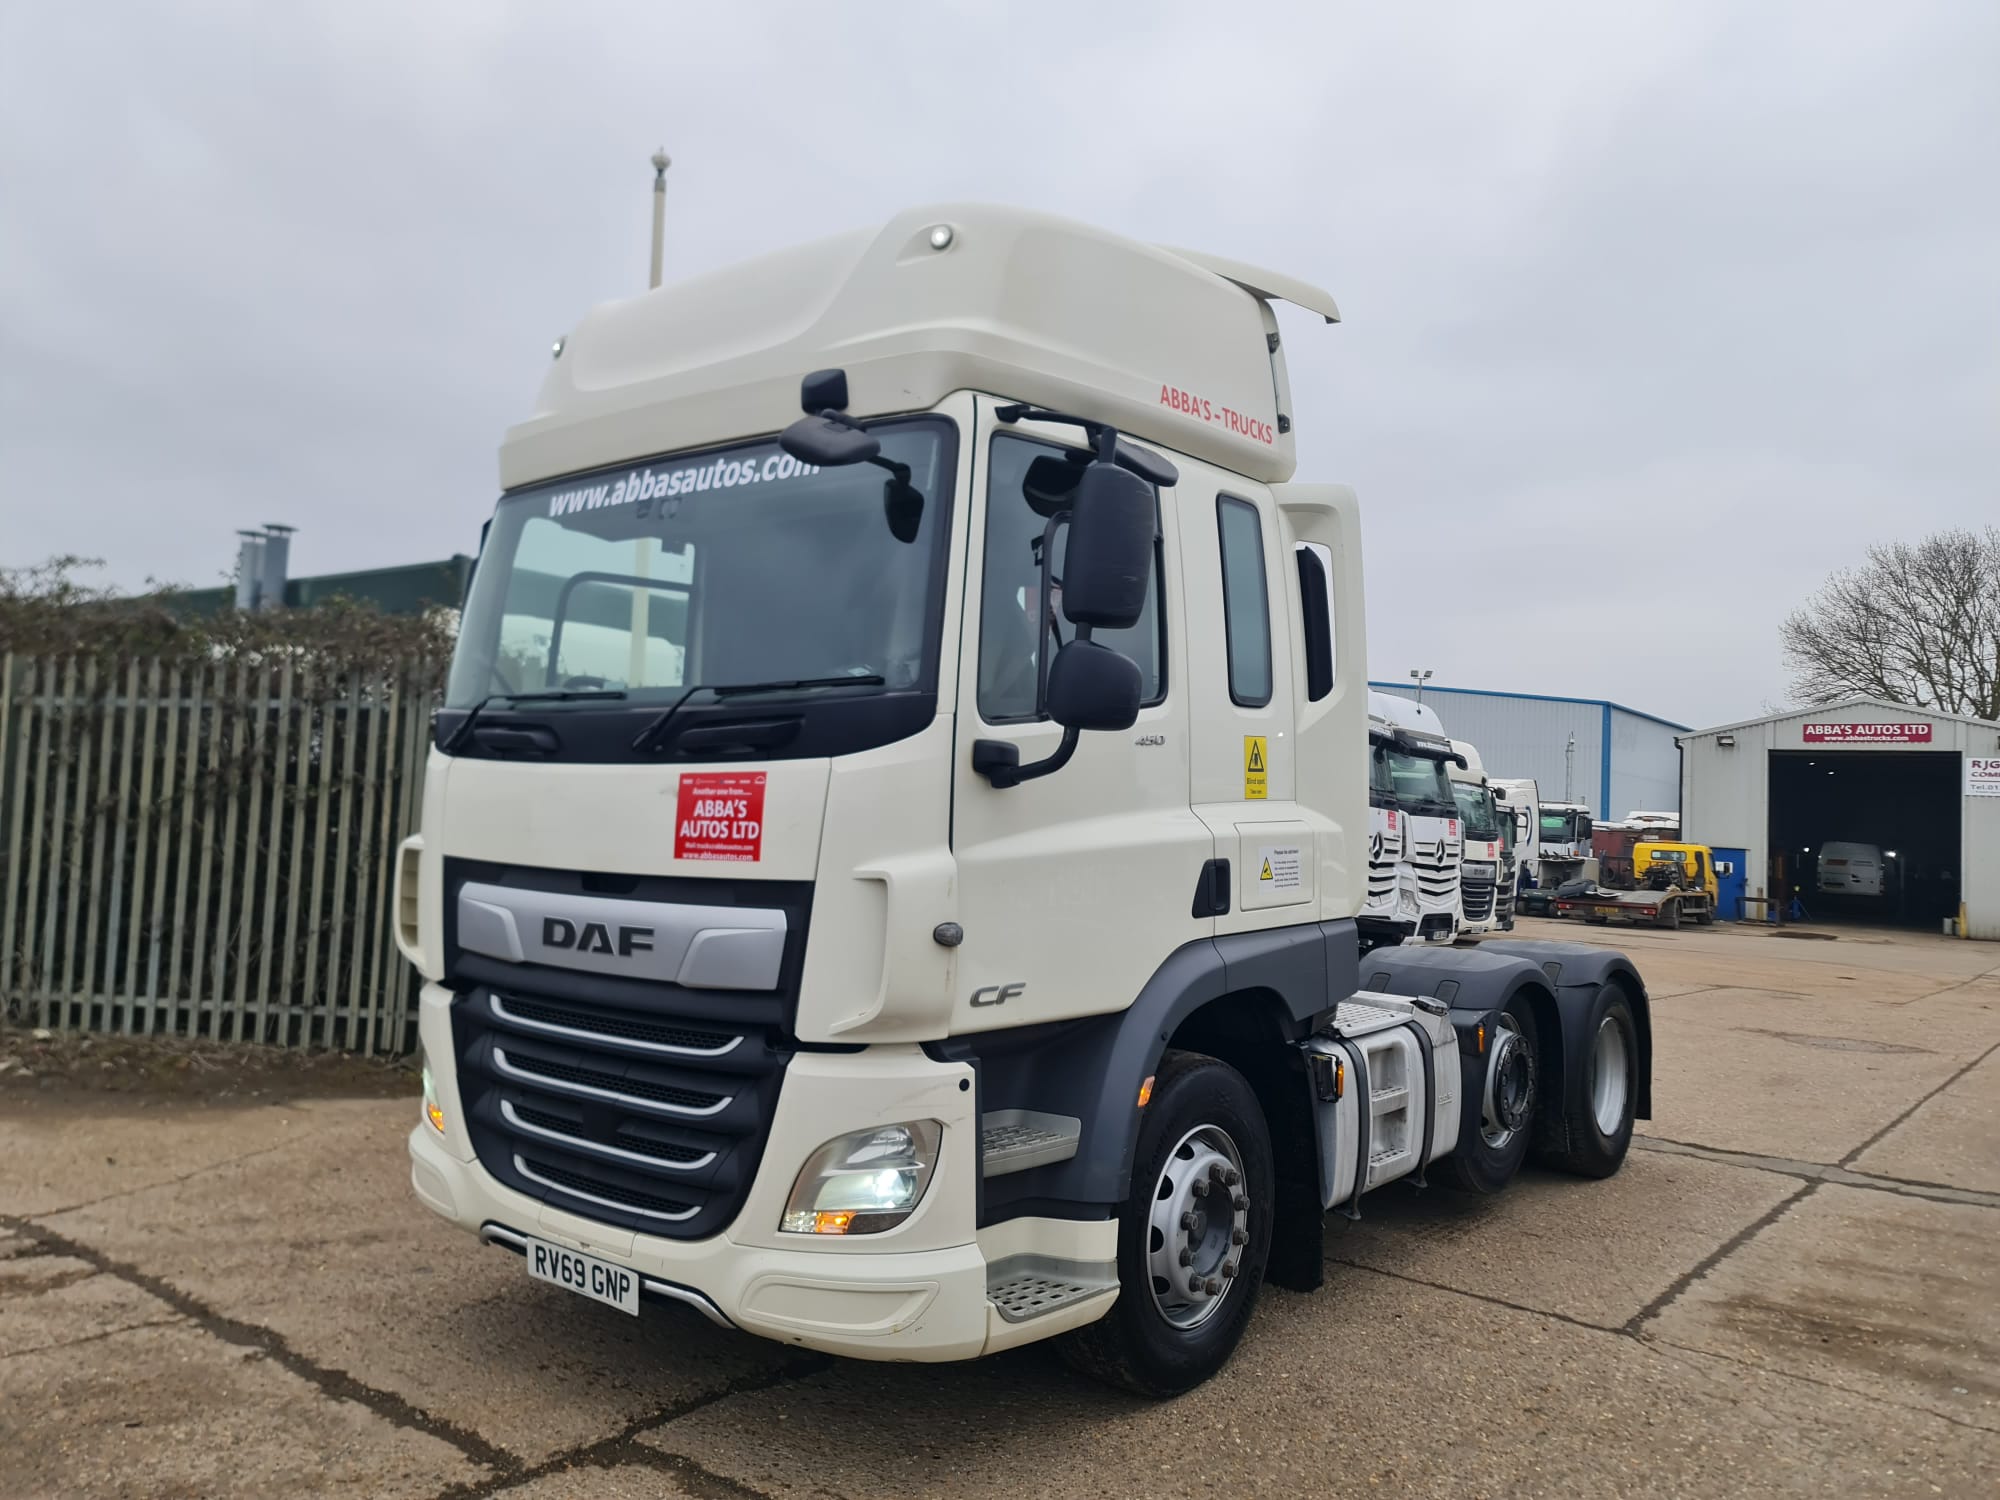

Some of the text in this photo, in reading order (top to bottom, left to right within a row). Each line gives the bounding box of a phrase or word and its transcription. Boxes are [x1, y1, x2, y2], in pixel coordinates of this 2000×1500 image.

[548, 453, 820, 518] www.abbasautos.com
[1805, 724, 1929, 735] ABBA'S AUTOS LTD
[693, 798, 748, 819] ABBA'S
[679, 819, 760, 839] AUTOS LTD
[542, 914, 656, 957] DAF
[969, 981, 1027, 1008] CF
[534, 1244, 631, 1304] RV69 GNP
